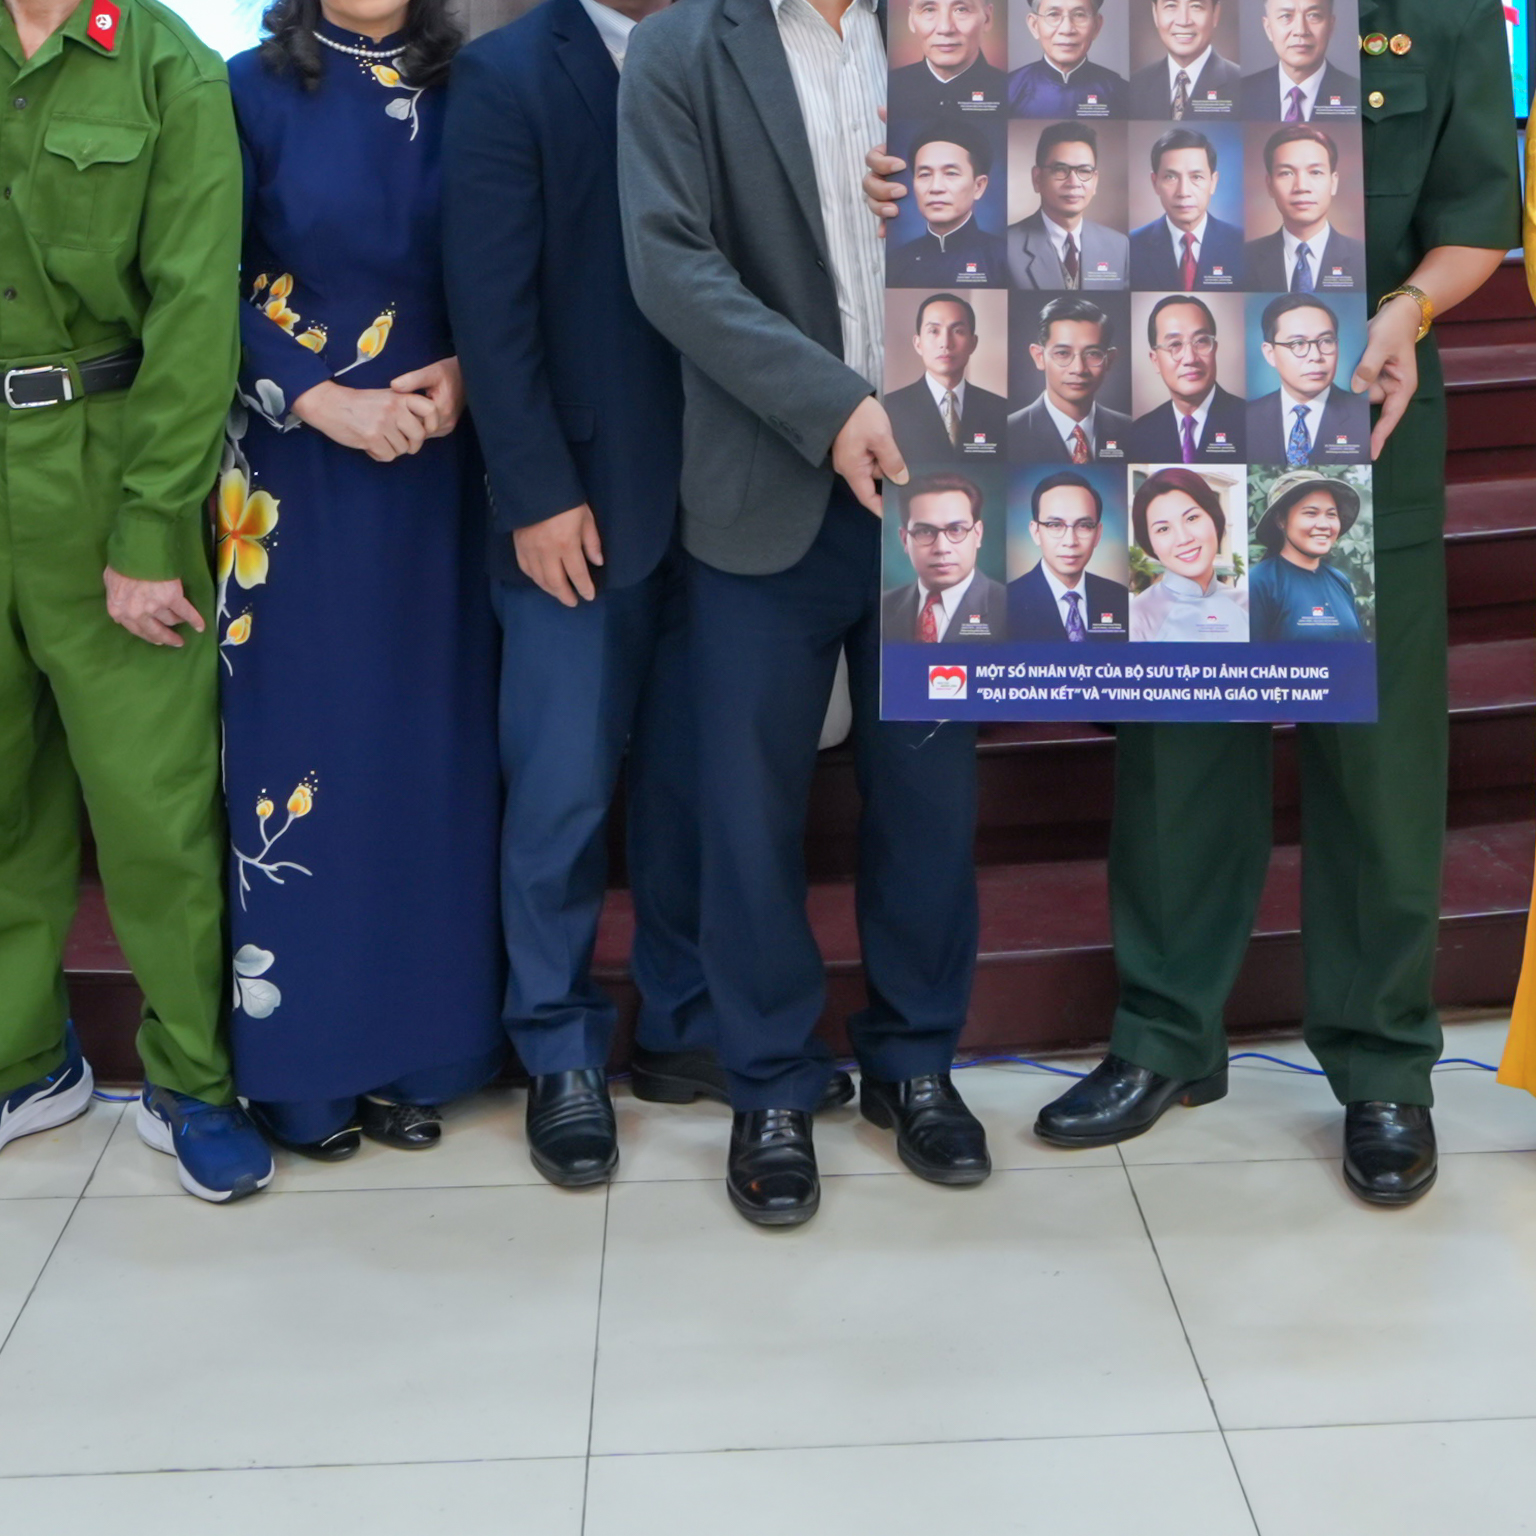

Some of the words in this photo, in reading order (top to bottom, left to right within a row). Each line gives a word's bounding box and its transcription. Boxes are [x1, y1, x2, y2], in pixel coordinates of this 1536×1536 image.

[976, 664, 1006, 681] MỘT
[1007, 662, 1026, 678] SỐ
[1028, 663, 1067, 678] NHÂN
[1068, 664, 1093, 681] VẬT
[1095, 663, 1122, 679] CỦA
[1124, 664, 1144, 681] BỘ
[1146, 664, 1174, 679] SƯU
[1175, 664, 1201, 682] TẬP
[1202, 667, 1217, 679] DI
[1219, 663, 1248, 679] ẢNH
[1250, 664, 1288, 679] CHÂN
[1290, 667, 1330, 679] DUNG
[1008, 686, 1048, 700] ĐOÀN
[1082, 686, 1100, 700] VÀ
[1142, 688, 1191, 702] QUANG
[1193, 686, 1222, 700] NHÀ
[1224, 686, 1258, 701] GIÁO
[1261, 687, 1290, 704] VIỆT
